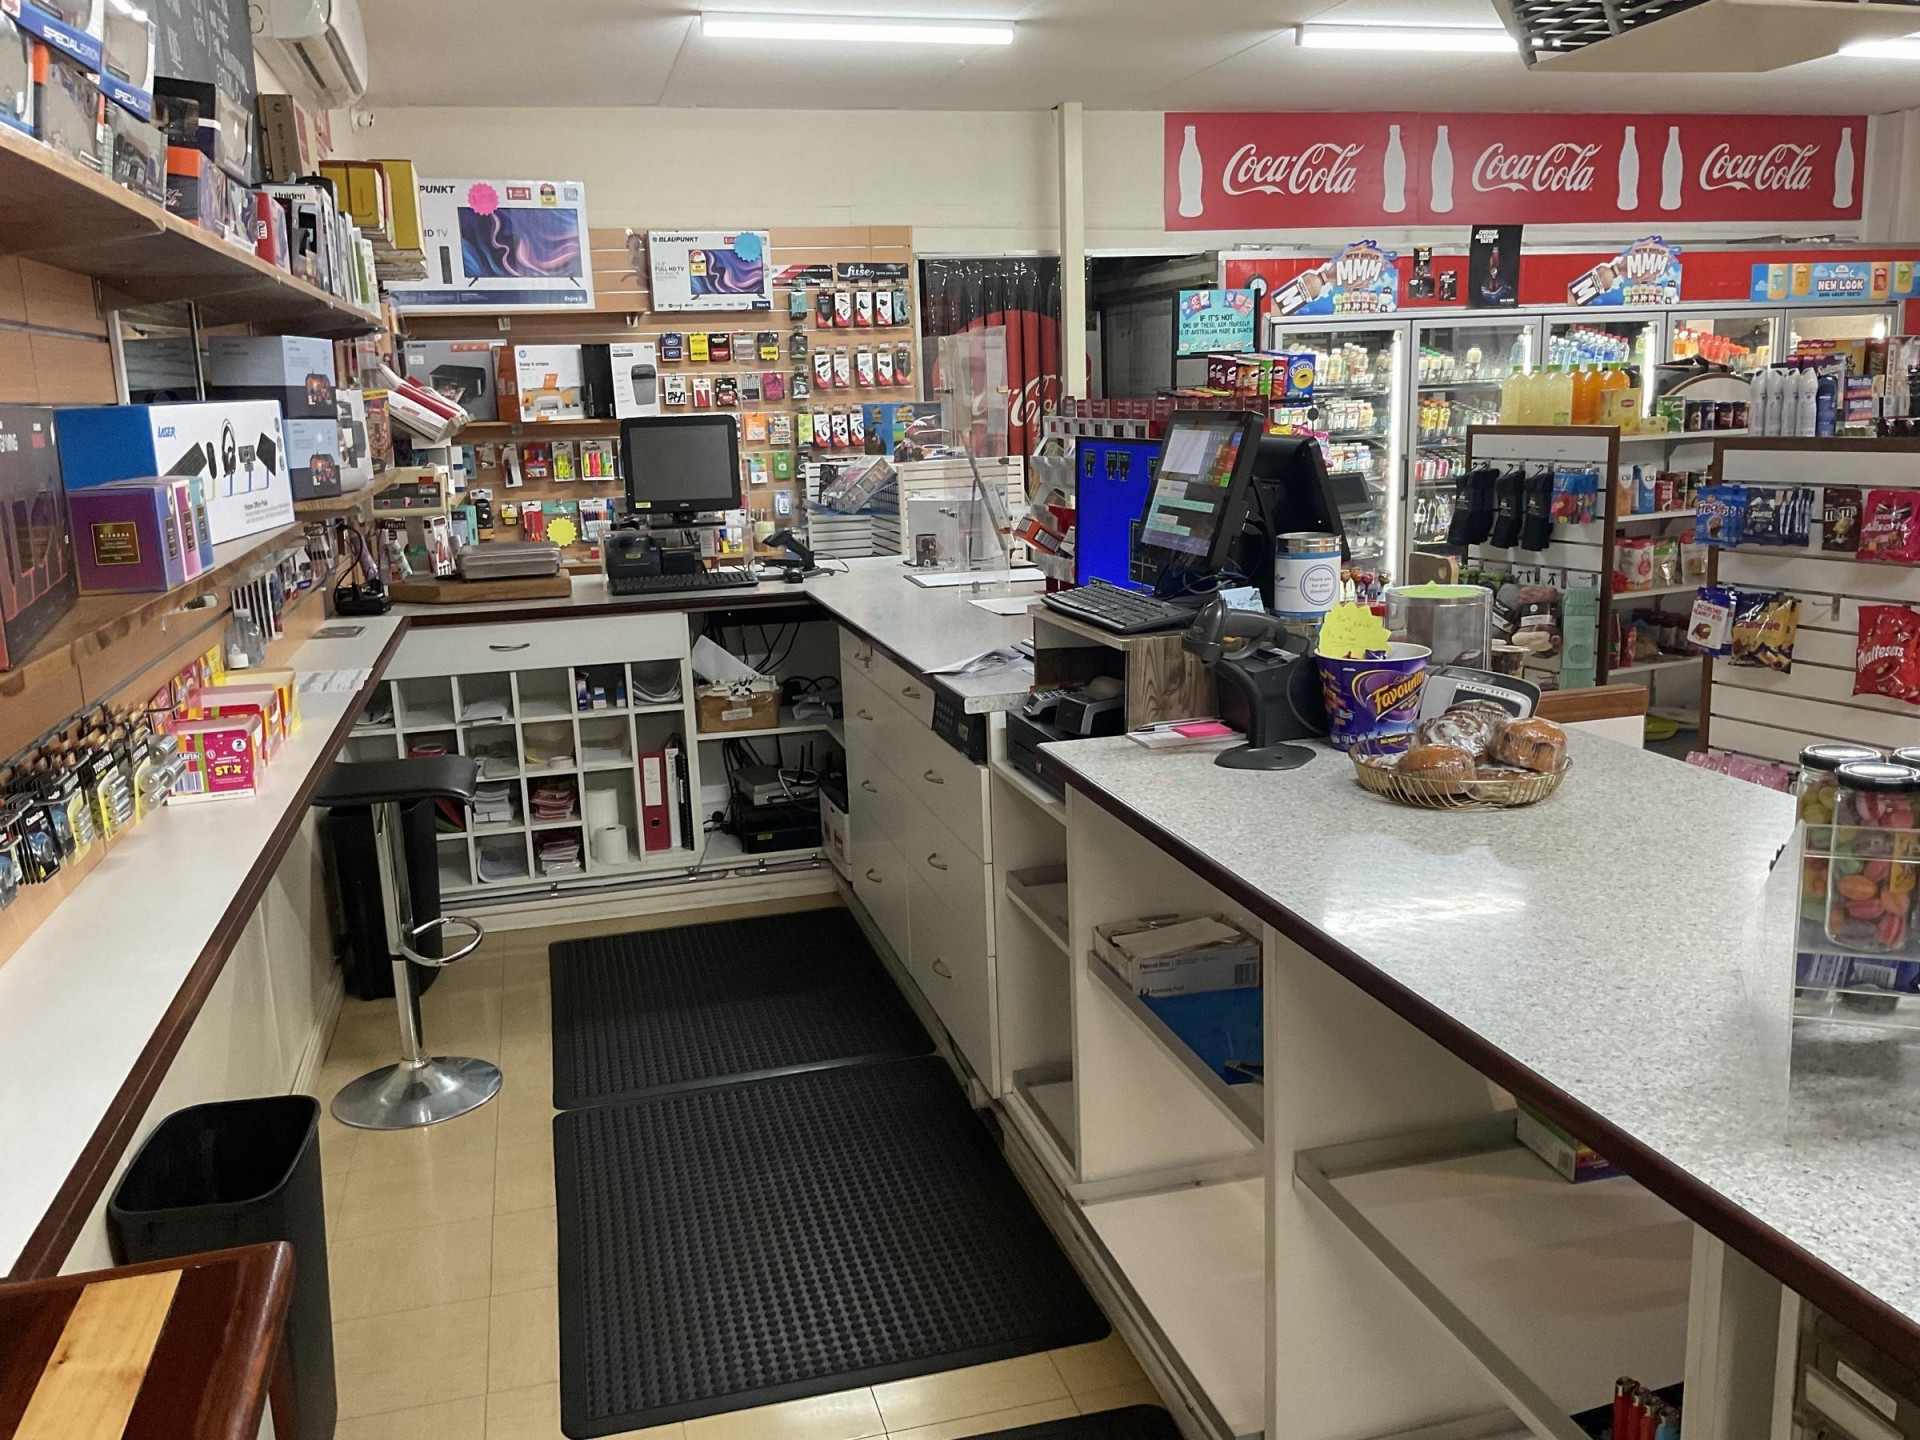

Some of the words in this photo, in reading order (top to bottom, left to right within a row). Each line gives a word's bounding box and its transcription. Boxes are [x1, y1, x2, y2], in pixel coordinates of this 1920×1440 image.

[43, 25, 82, 53] SPECIAL
[1222, 143, 1366, 196] Coca-Cola
[1471, 142, 1603, 193] Coca-Cola
[1699, 142, 1821, 191] Coca-Cola
[274, 191, 306, 200] Uniden
[436, 229, 448, 237] TV
[847, 265, 875, 280] fuse
[1336, 259, 1383, 286] MMM
[1627, 254, 1669, 279] MMM
[1817, 280, 1837, 291] NEW
[1839, 279, 1864, 291] LOOK
[158, 426, 177, 439] LASER
[1862, 520, 1908, 532] Allsorts
[93, 753, 114, 774] TOSHIBA
